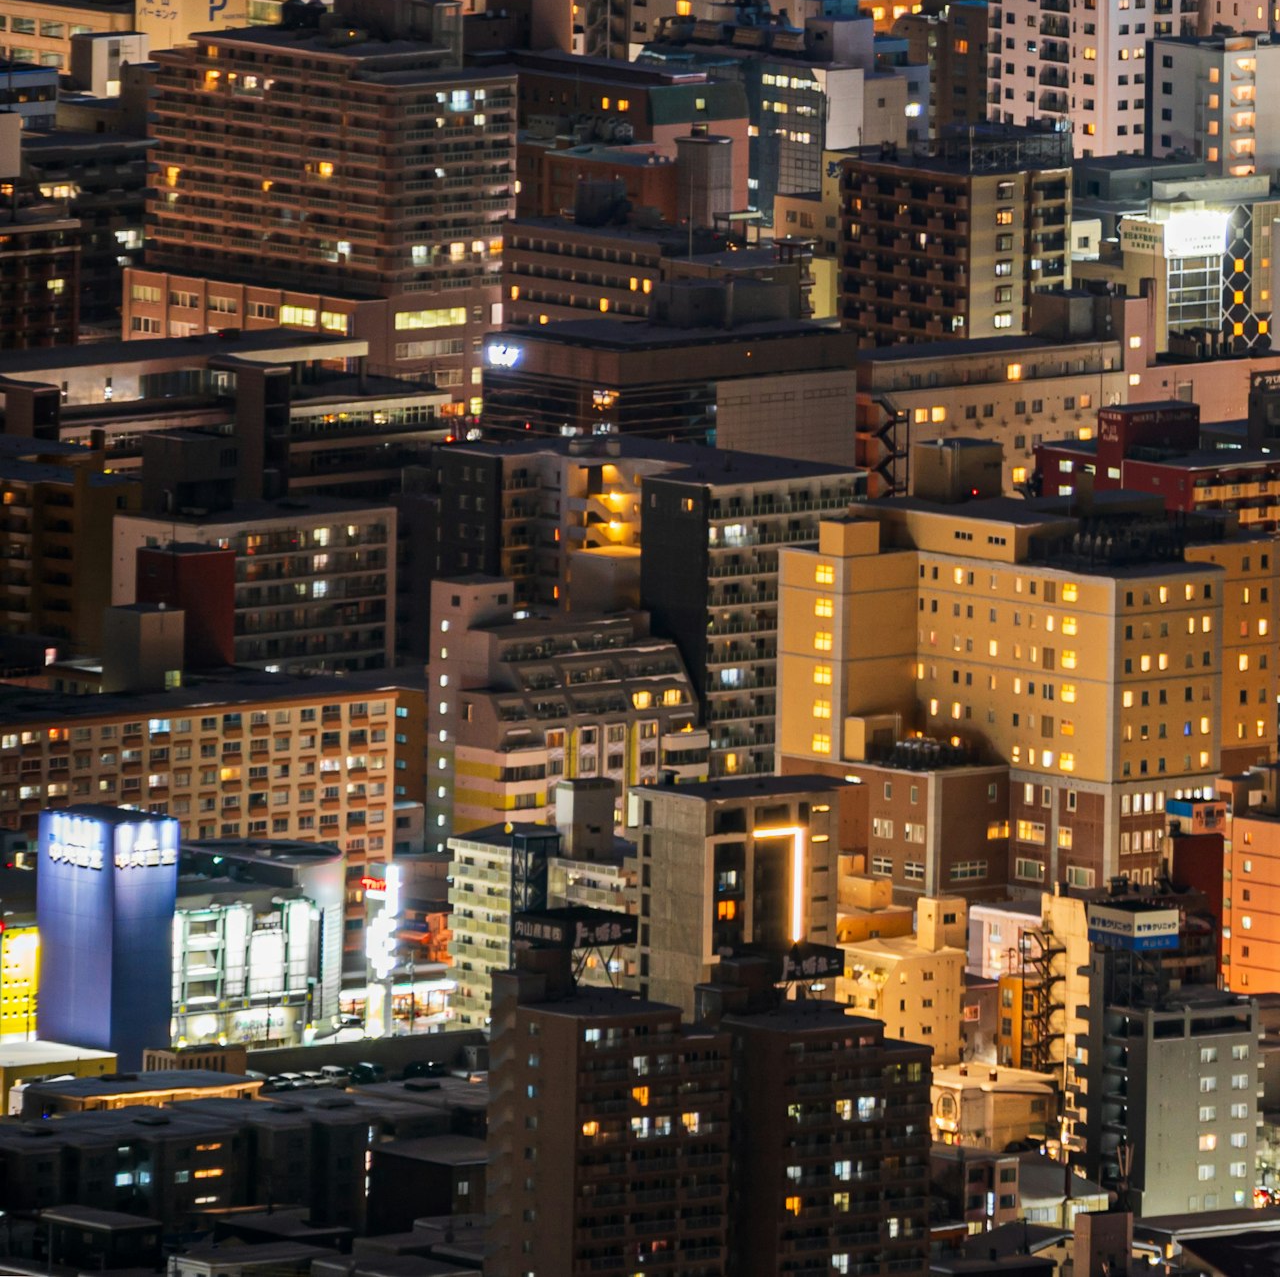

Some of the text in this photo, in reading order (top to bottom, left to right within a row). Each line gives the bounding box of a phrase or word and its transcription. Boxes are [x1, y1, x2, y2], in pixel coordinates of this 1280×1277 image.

[139, 7, 178, 20] パーキング
